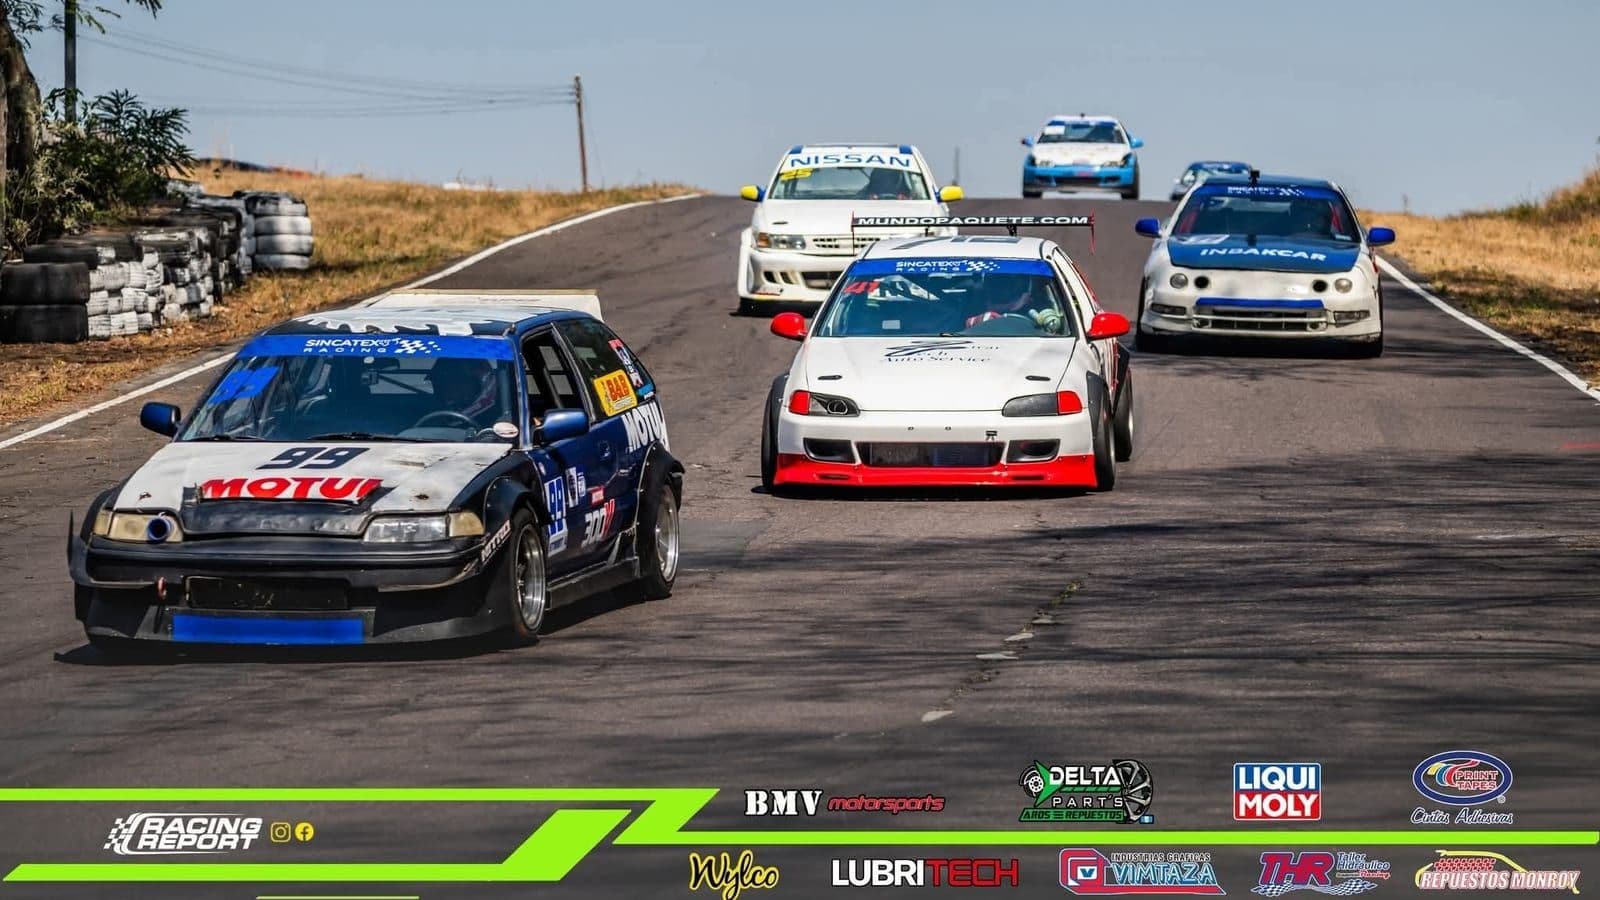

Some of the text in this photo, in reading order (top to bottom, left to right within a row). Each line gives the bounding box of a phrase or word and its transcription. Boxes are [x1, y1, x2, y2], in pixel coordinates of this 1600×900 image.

[791, 154, 910, 168] NISSAN
[858, 216, 1088, 225] MUNDOPAQUETE.COM
[305, 339, 379, 347] SINCATEX
[255, 447, 370, 470] 99
